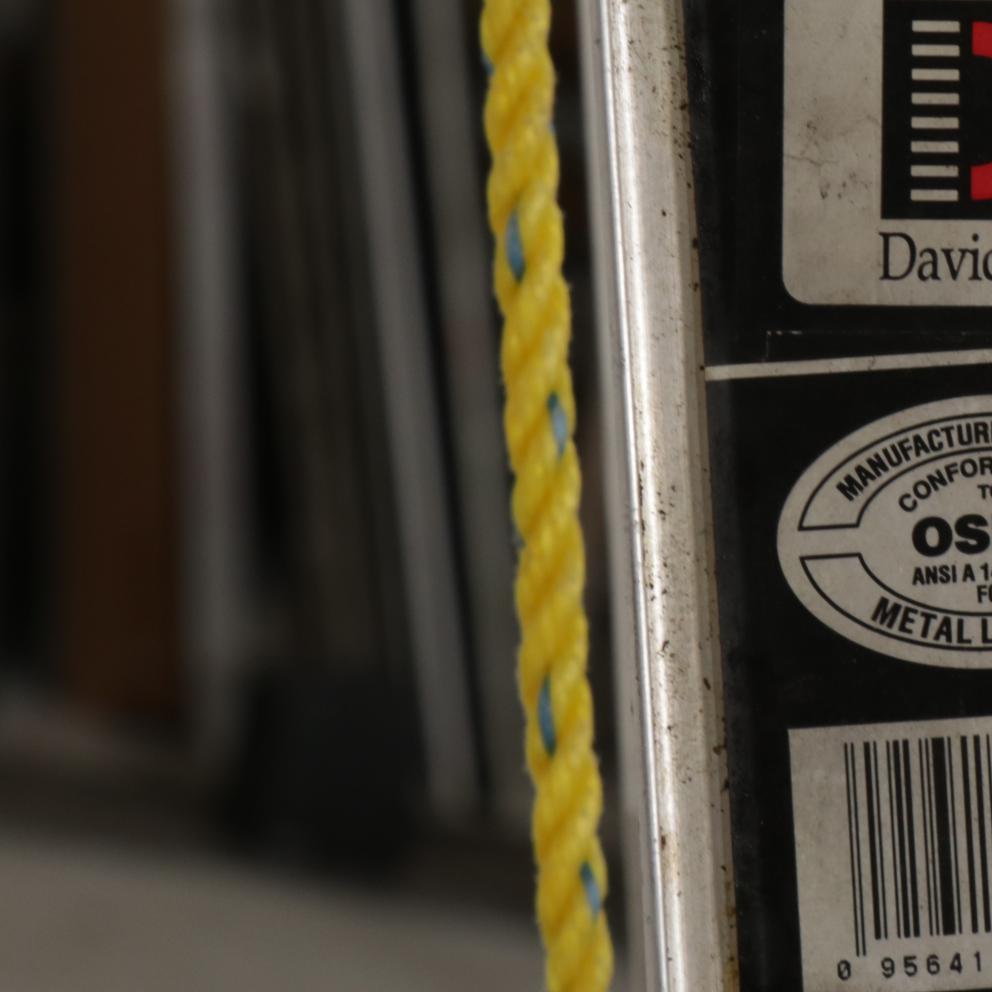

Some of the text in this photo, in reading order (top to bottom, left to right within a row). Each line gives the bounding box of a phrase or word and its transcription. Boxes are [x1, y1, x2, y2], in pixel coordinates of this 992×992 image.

[913, 564, 957, 586] ANSI
[962, 563, 976, 581] A
[871, 598, 972, 644] METAL
[837, 961, 851, 980] 0
[882, 952, 982, 979] 95641
